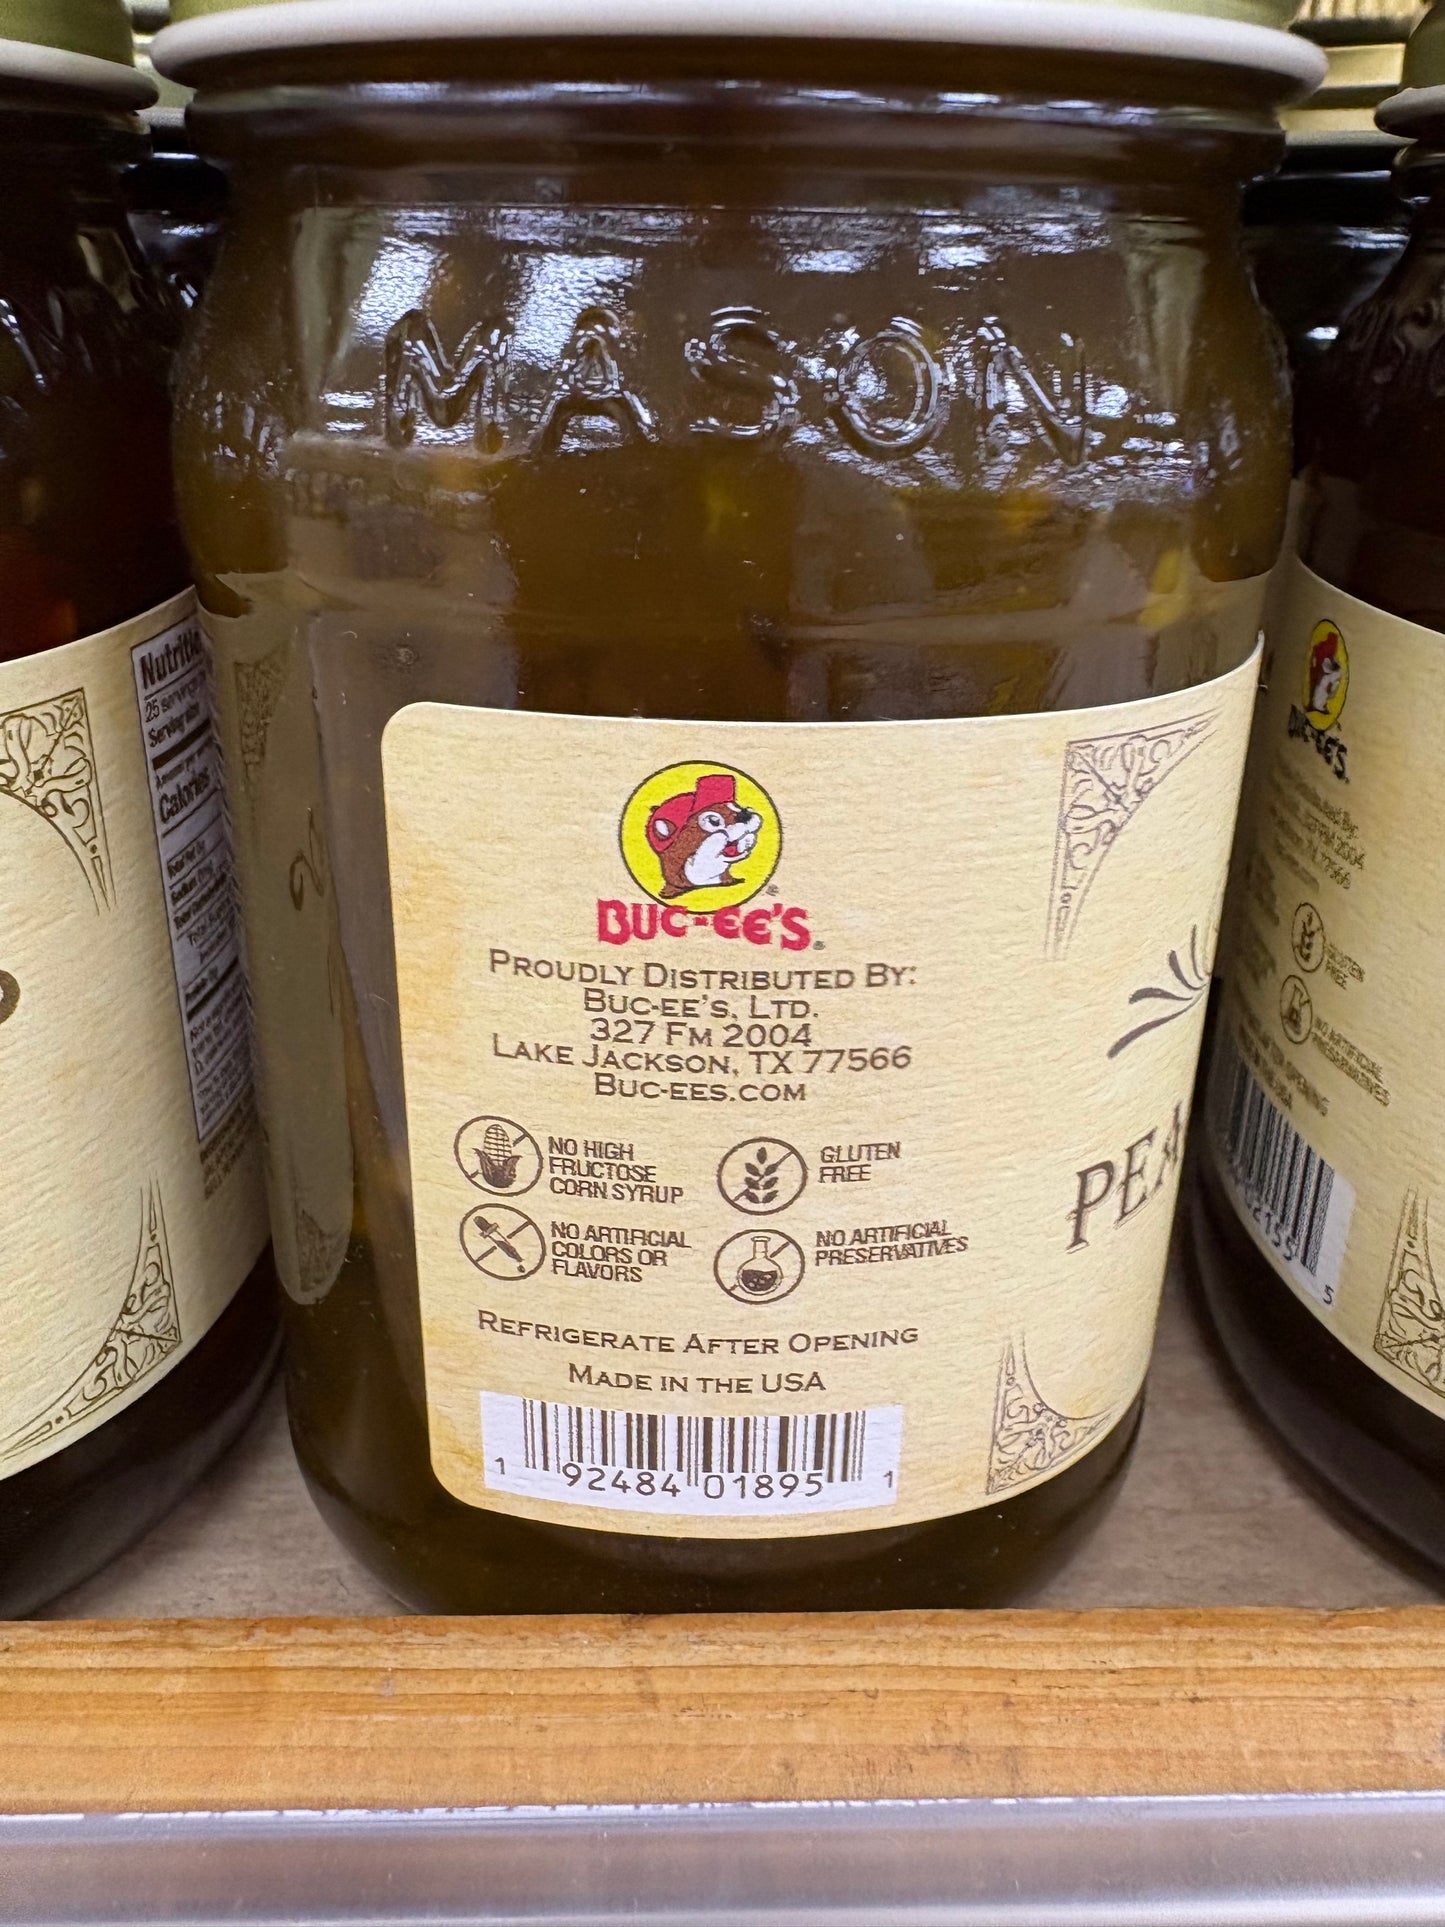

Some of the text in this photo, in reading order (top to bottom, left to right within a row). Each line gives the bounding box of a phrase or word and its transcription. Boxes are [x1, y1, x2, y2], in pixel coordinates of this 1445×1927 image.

[380, 306, 1093, 470] MASON
[597, 898, 812, 951] BUC-EE'S
[489, 948, 918, 991] PROUDLY DISTRIBUTED BY:
[583, 987, 820, 1022] BUC-EE'S, LTD.
[590, 1017, 813, 1048] 327 FM 2004
[492, 1032, 913, 1078] LAKE JACKSON, TX 77566
[594, 1071, 808, 1102] BUC-EES.COM
[548, 1136, 635, 1162] NO HIGH
[820, 1140, 902, 1164] GLUTEN
[548, 1157, 658, 1184] FRUCTOSE
[817, 1163, 873, 1184] FREE
[549, 1176, 685, 1205] CORN SYRUP
[550, 1220, 693, 1249] NO ARTIFICIAL
[815, 1219, 954, 1248] NO ARTIFICIAL
[551, 1241, 669, 1267] COLORS OR
[814, 1235, 970, 1267] PRESERVATIVES
[551, 1258, 644, 1283] FLAVORS
[1323, 1283, 1335, 1305] 5
[477, 1309, 920, 1356] REFRIGERATE AFTER OPENING
[568, 1362, 827, 1395] MADE IN THE USA
[493, 1457, 895, 1500] 1 92484 01895 1
